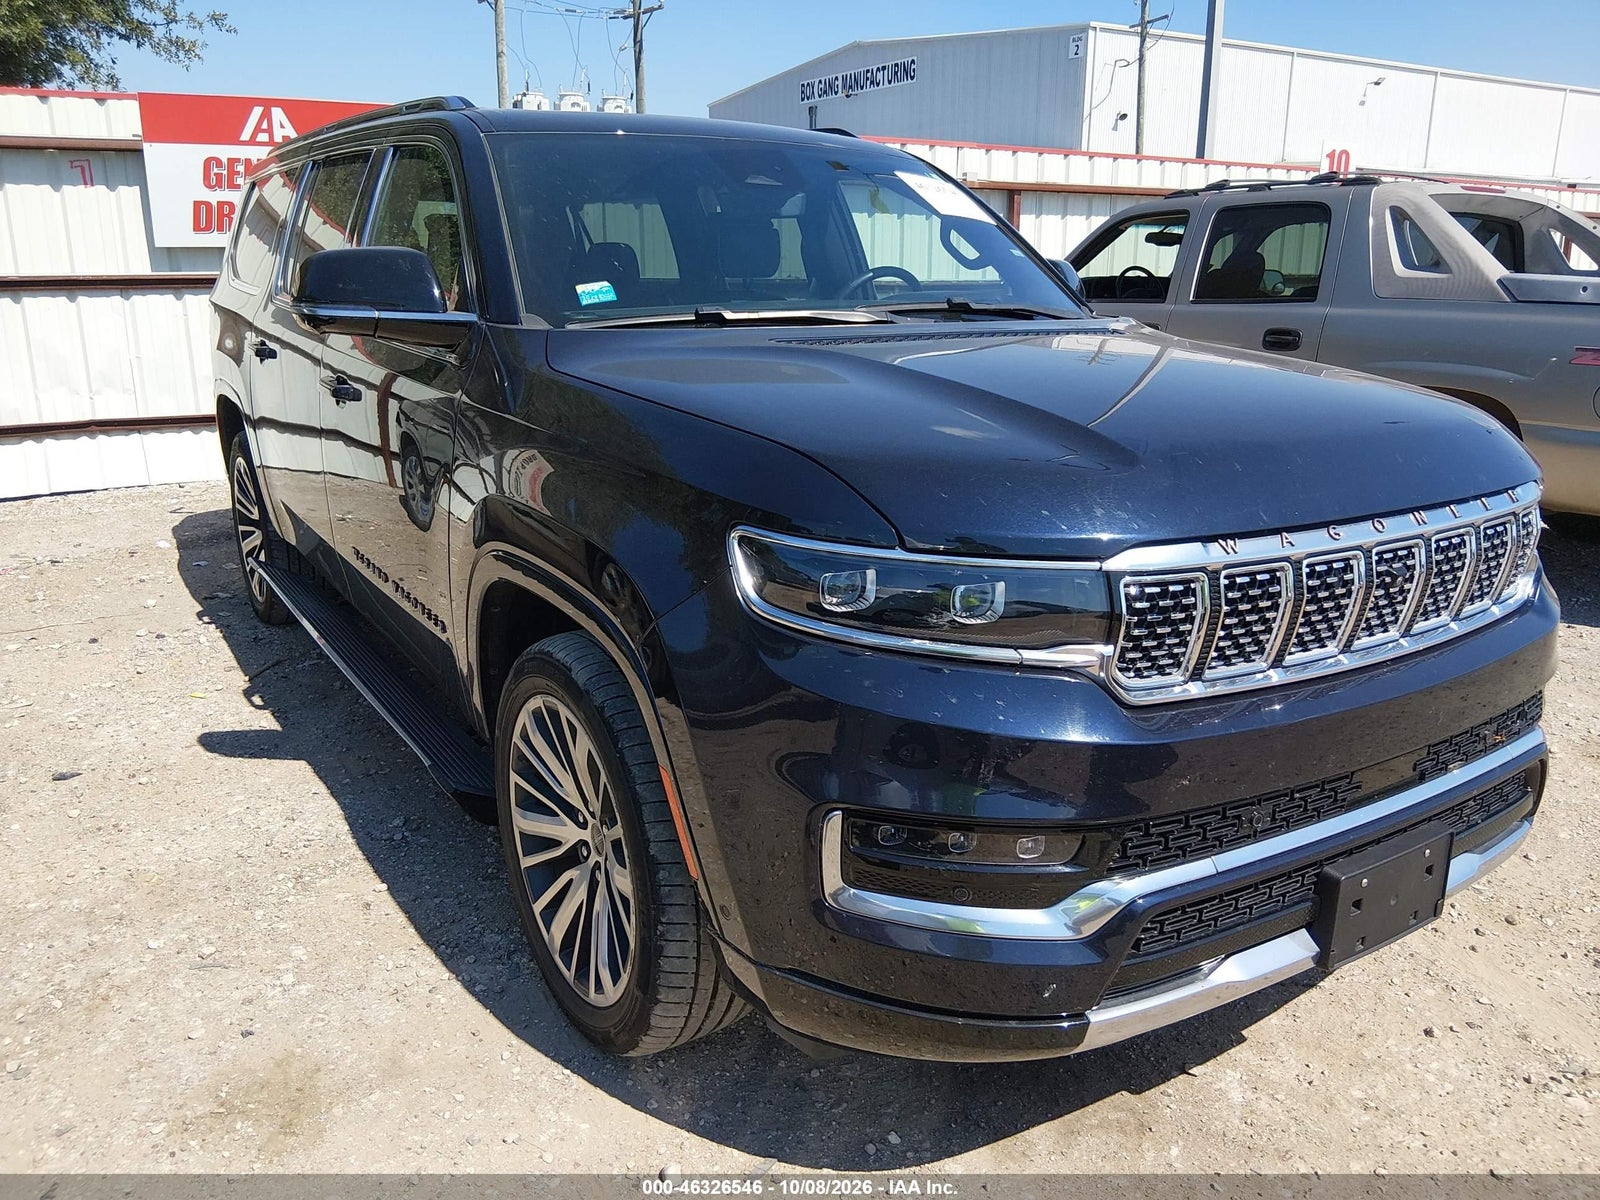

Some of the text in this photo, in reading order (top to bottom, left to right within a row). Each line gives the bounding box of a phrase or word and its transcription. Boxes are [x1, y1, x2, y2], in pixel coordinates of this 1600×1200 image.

[1071, 35, 1083, 43] BLDG
[1074, 44, 1080, 56] 2
[800, 59, 916, 102] BOX GANG MANUFACTURING
[1326, 149, 1350, 179] 10
[1217, 489, 1520, 555] WAGONEER
